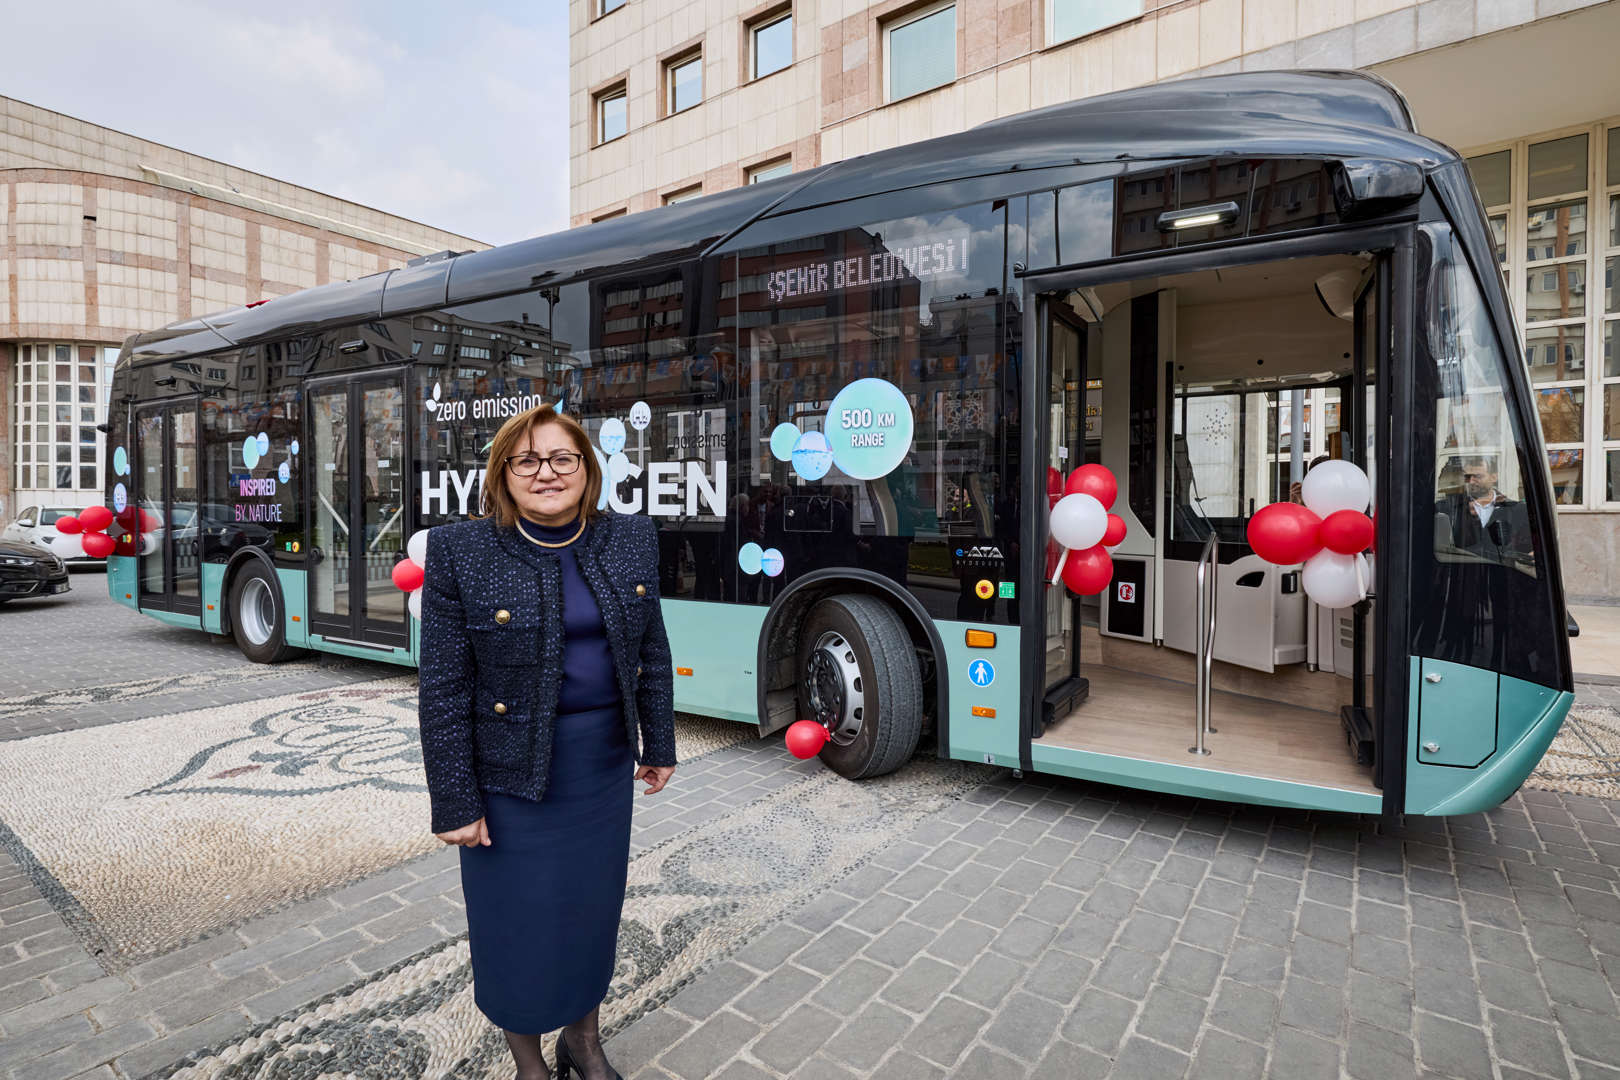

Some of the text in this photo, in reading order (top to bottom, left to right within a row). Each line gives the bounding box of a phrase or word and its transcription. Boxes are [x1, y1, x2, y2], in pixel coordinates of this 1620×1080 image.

[436, 390, 541, 421] zero emission
[841, 408, 895, 428] 500 KM
[851, 433, 884, 447] RANGE
[240, 478, 275, 496] INSPIRED
[421, 460, 728, 517] HYGEN
[235, 503, 282, 522] BY NATURE
